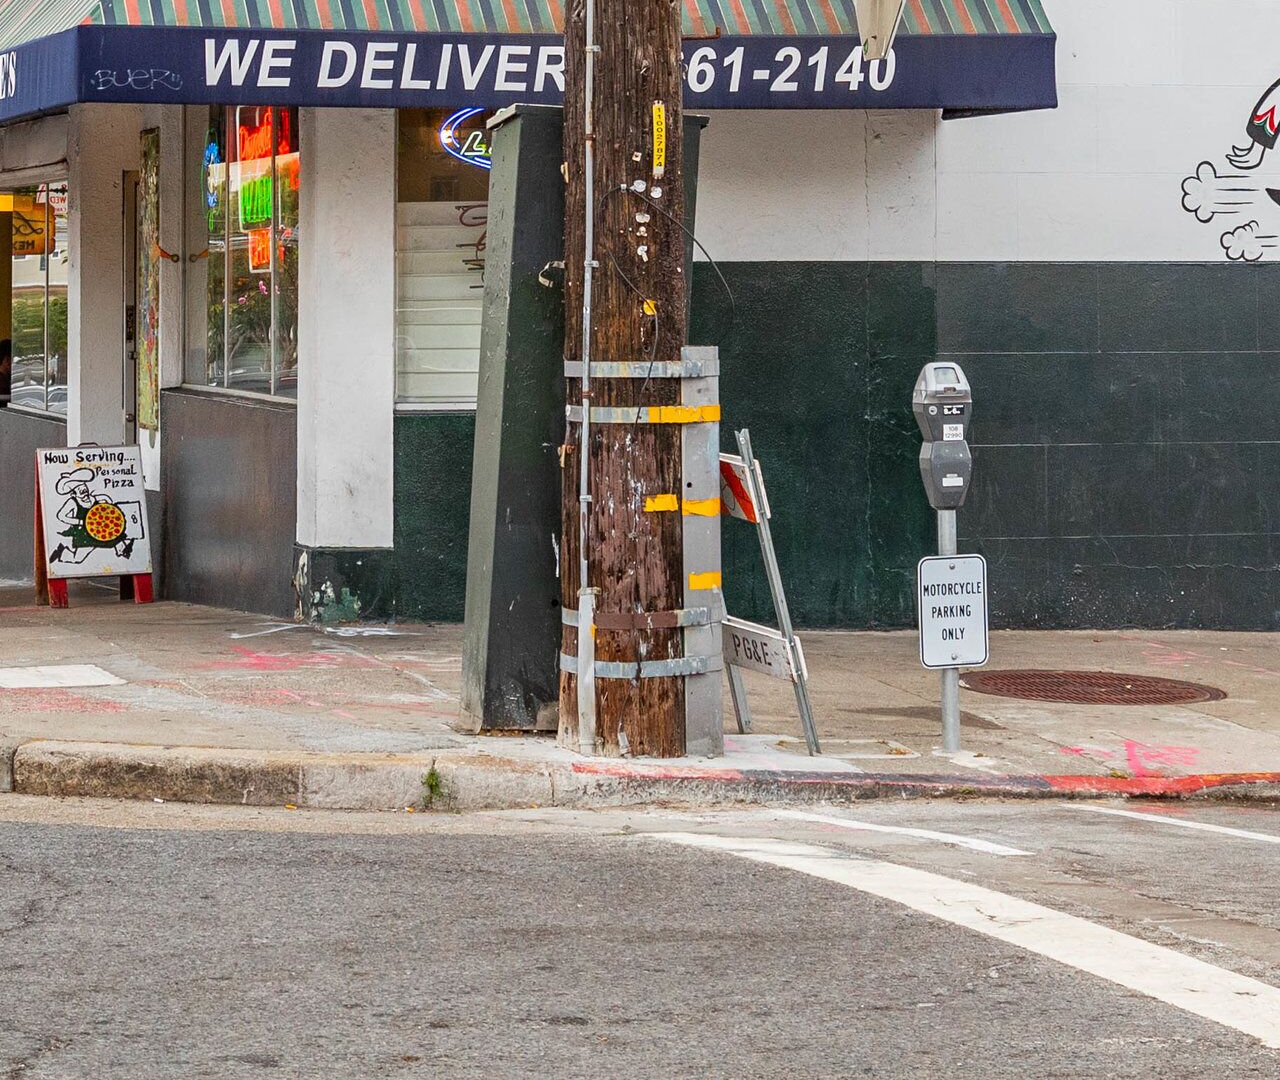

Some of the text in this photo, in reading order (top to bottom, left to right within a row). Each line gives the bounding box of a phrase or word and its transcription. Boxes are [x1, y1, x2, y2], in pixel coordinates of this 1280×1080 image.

[203, 40, 296, 90] WE
[681, 45, 898, 93] 61-2140
[104, 478, 135, 489] Pizza
[923, 581, 982, 597] MOTORCYCLE
[931, 604, 971, 618] PARKING
[941, 628, 965, 641] ONLY
[732, 633, 772, 666] PG&E
